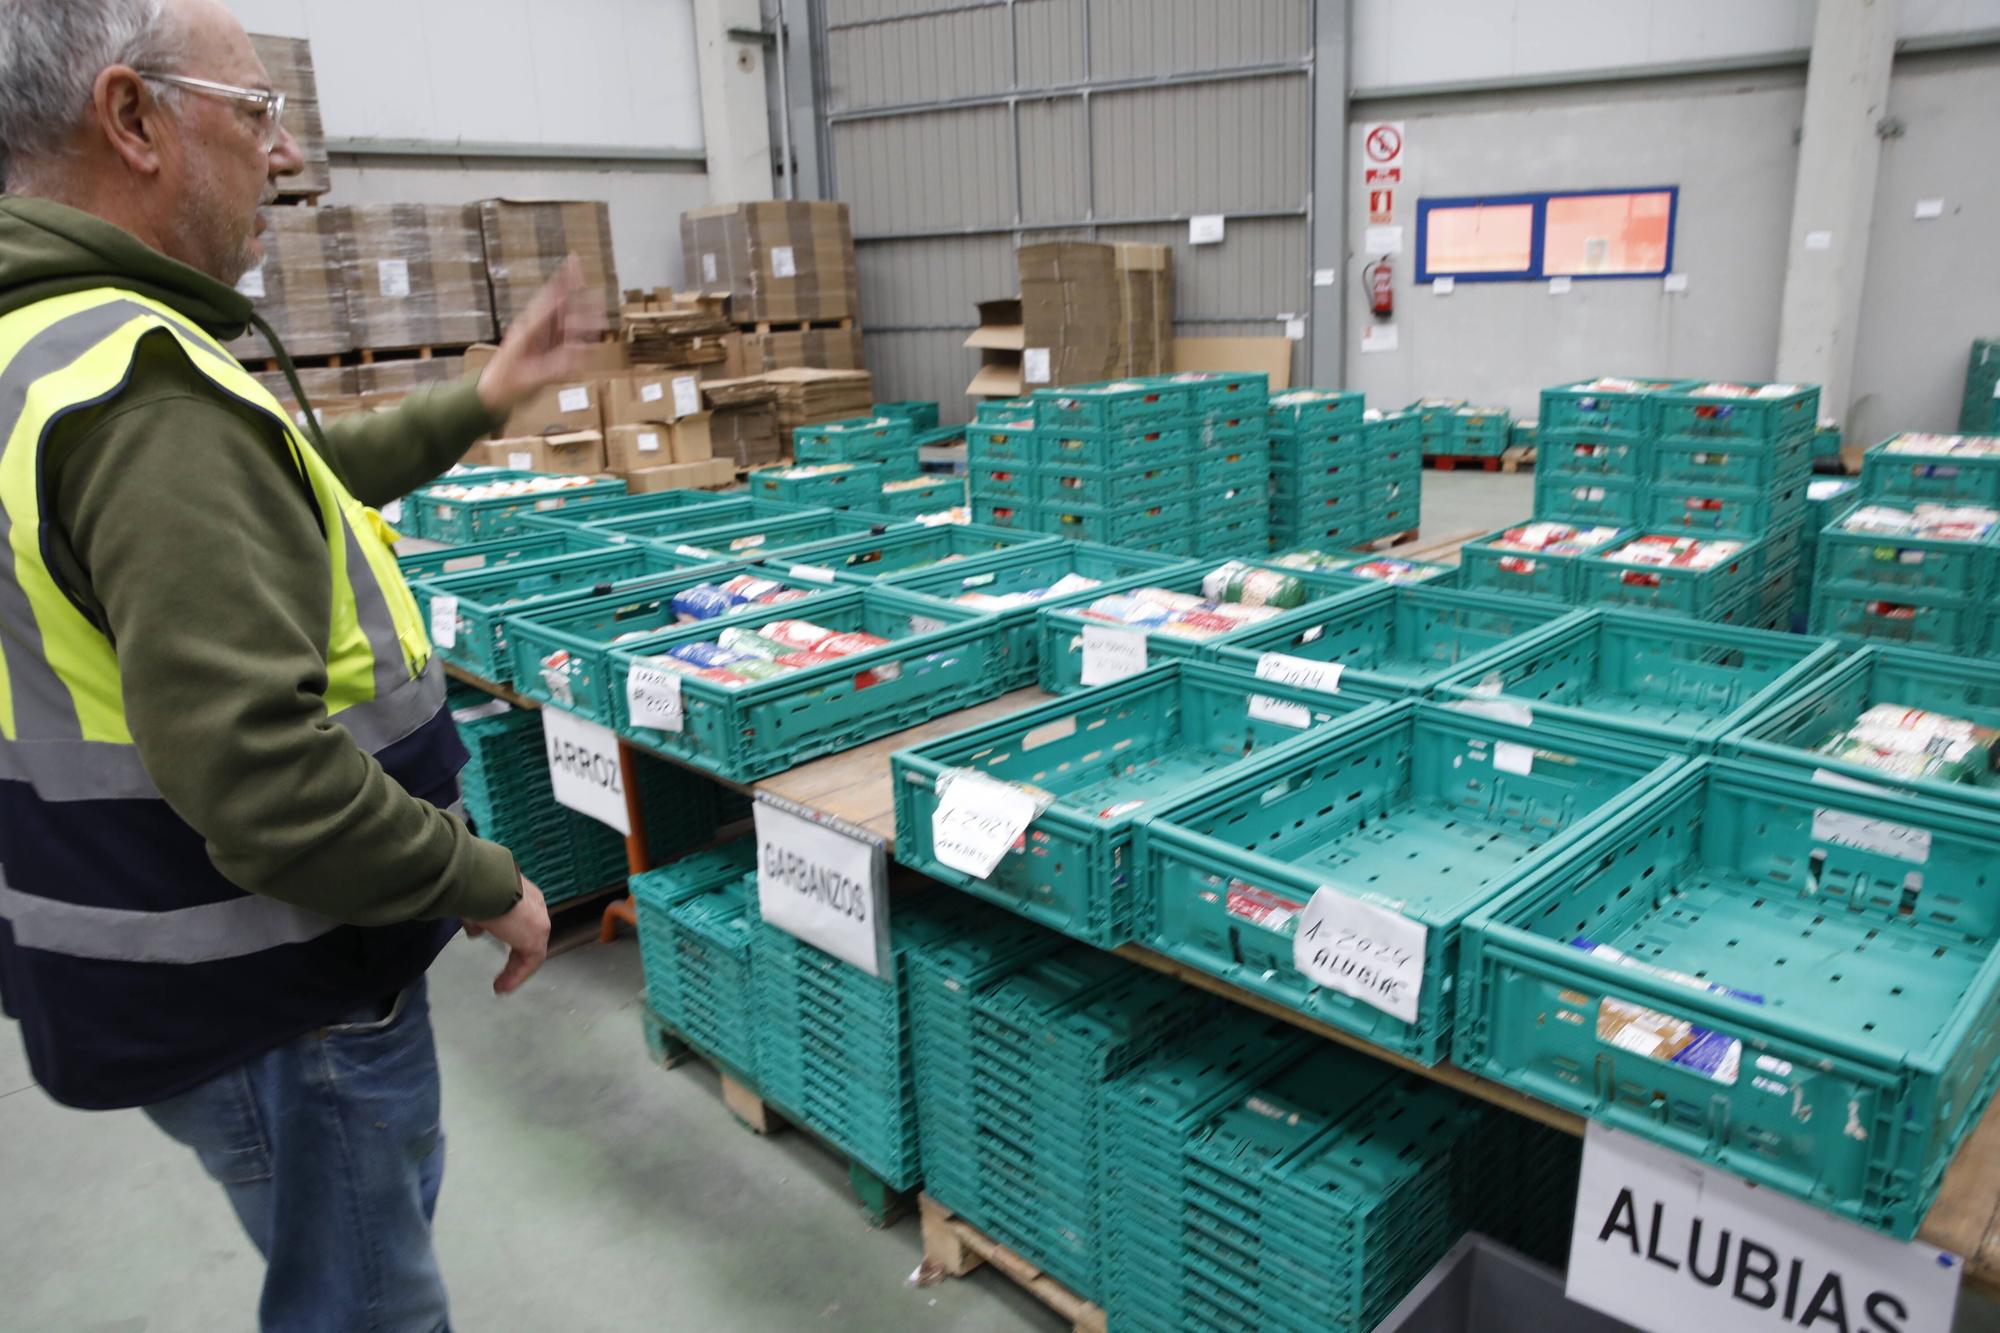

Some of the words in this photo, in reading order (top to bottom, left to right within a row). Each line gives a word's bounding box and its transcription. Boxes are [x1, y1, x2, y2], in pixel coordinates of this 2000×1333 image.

[553, 737, 623, 794] ARROZ
[764, 841, 866, 923] GARBANZOS
[1312, 947, 1409, 1004] ALUBIAS
[1597, 1186, 1909, 1333] ALUBIAS
